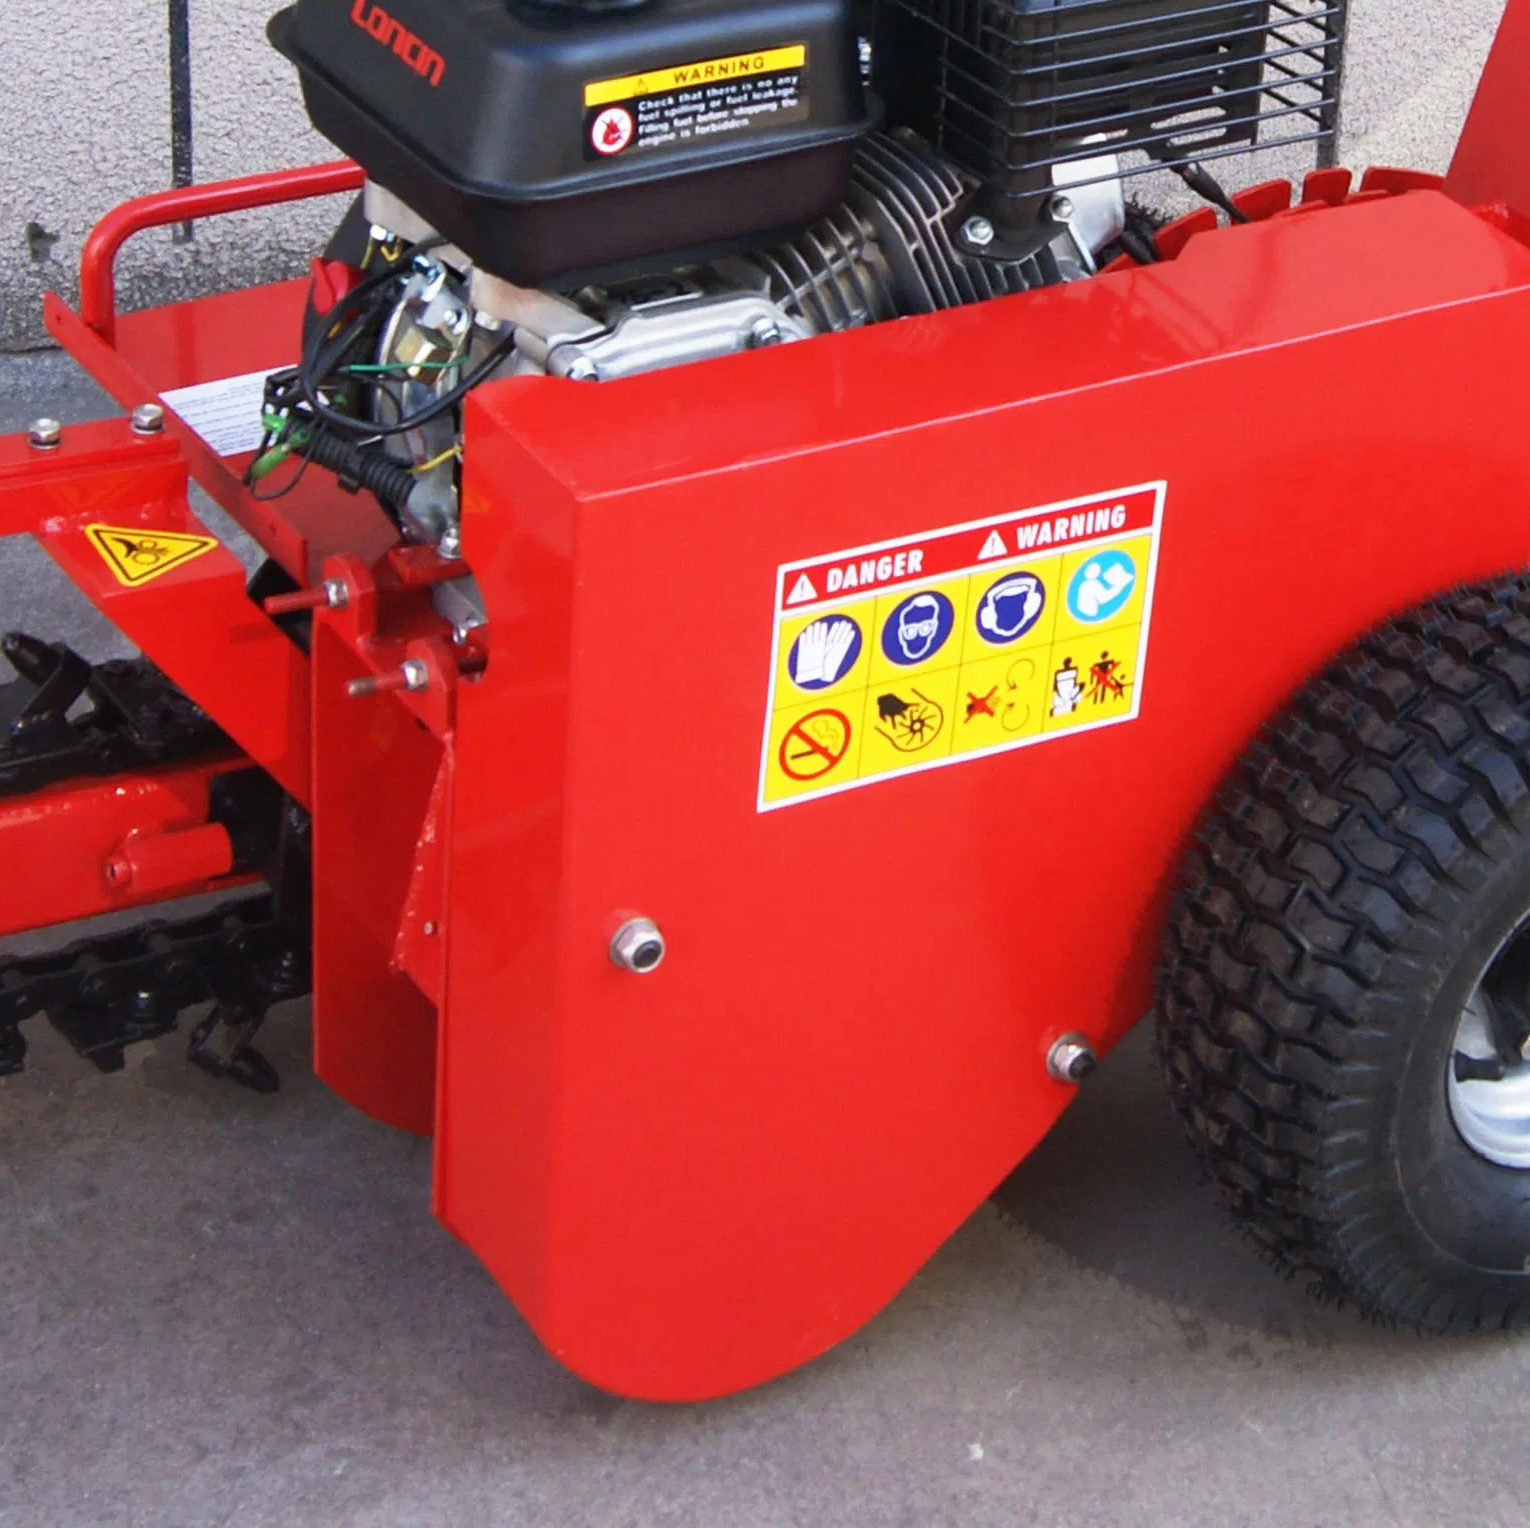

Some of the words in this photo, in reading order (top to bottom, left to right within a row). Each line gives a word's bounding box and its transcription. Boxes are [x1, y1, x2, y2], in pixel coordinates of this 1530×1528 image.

[673, 56, 765, 84] WARNING
[638, 95, 674, 112] Check
[679, 90, 702, 103] that
[706, 85, 737, 99] there
[741, 82, 753, 91] is
[757, 79, 773, 88] no
[777, 75, 799, 85] any
[638, 110, 660, 122] fuel
[710, 99, 721, 108] or
[726, 93, 748, 104] fuel
[673, 116, 693, 128] fuel
[781, 98, 799, 108] the
[638, 132, 676, 147] engine
[680, 129, 691, 138] is
[826, 550, 924, 594] DANGER
[1016, 505, 1127, 551] WARNING
